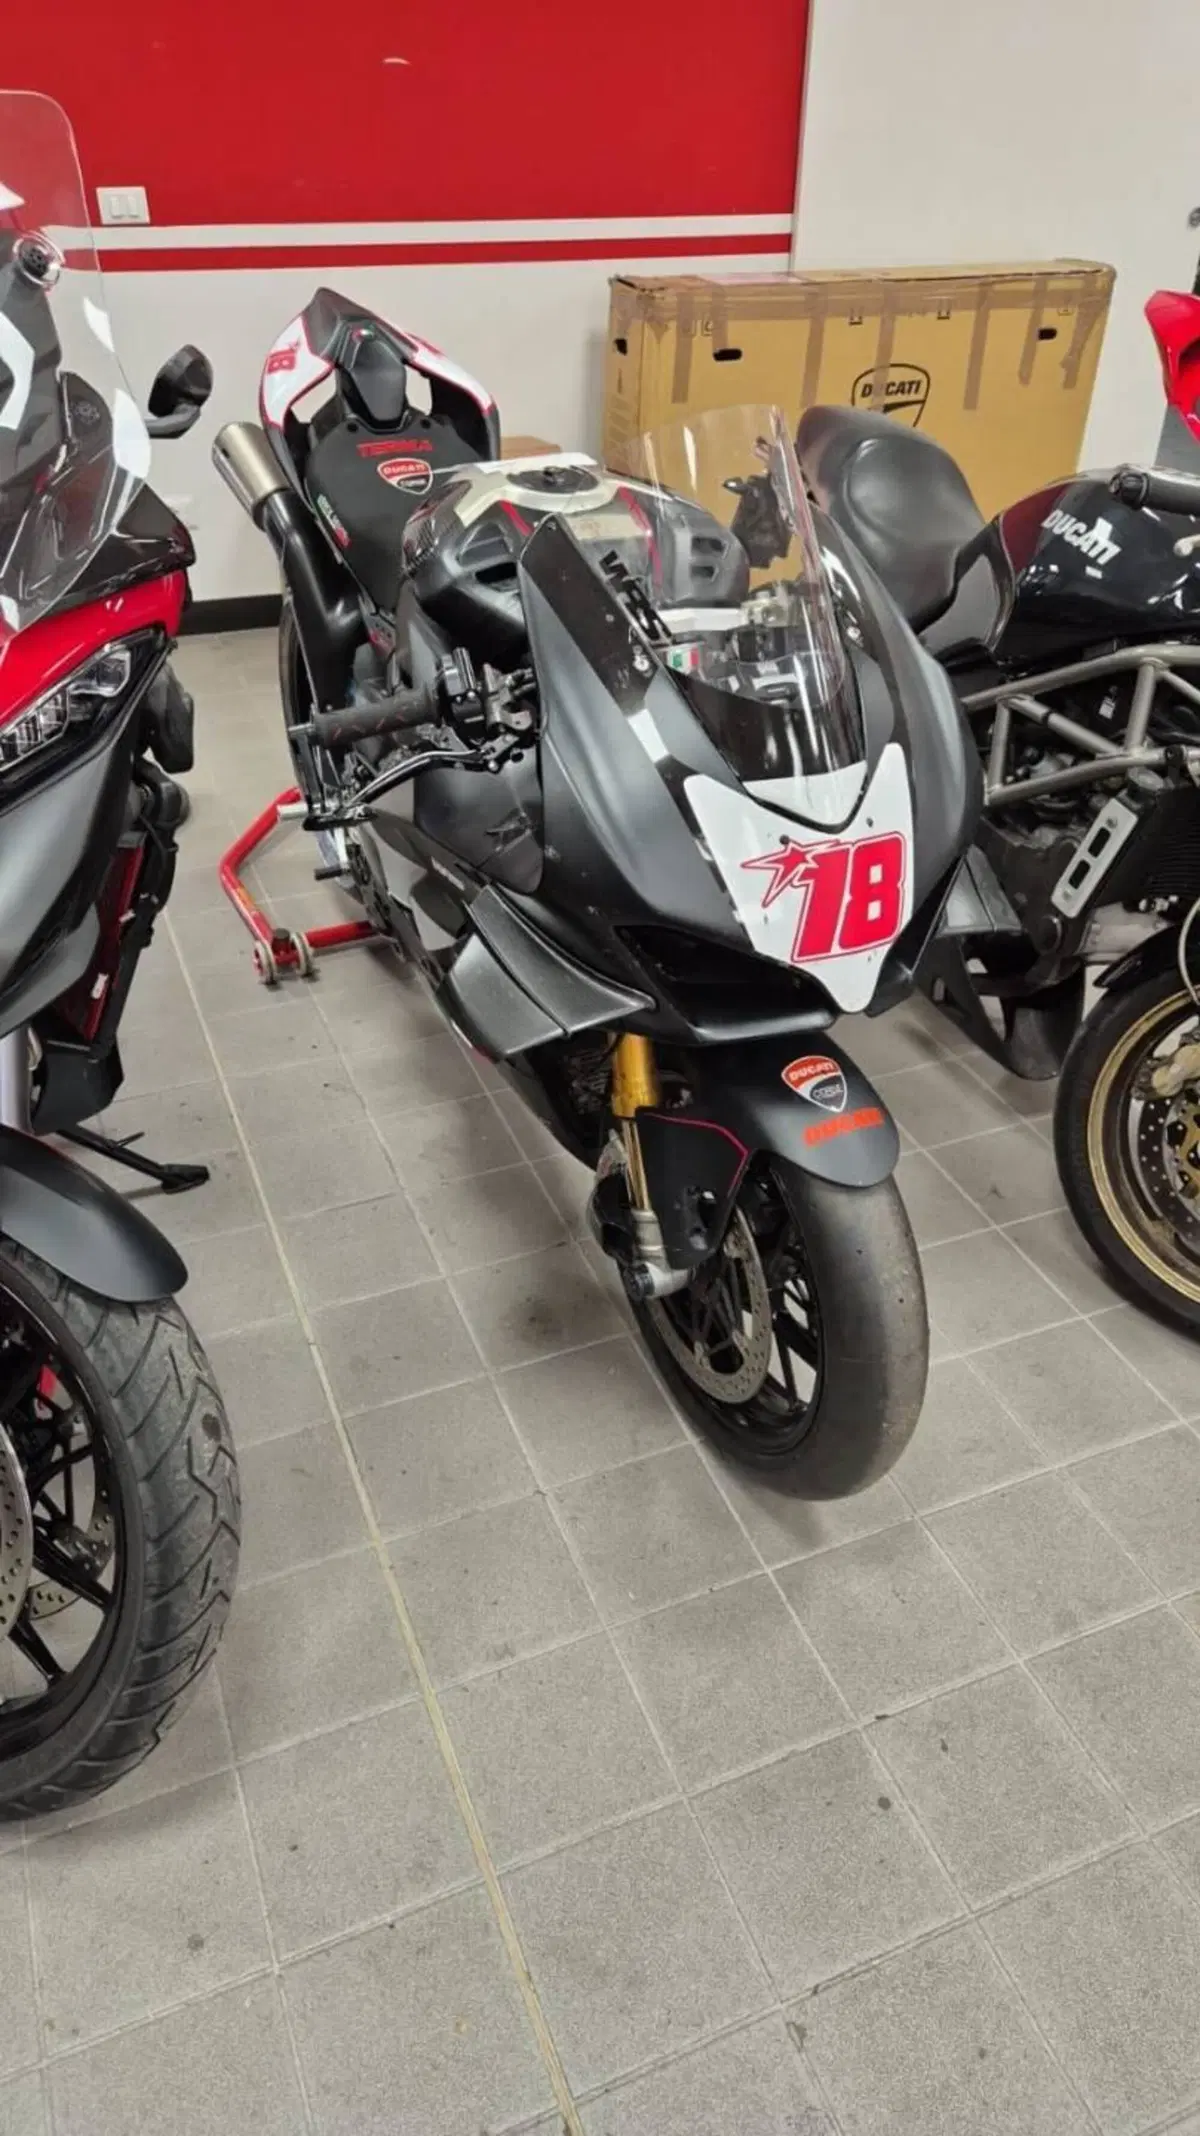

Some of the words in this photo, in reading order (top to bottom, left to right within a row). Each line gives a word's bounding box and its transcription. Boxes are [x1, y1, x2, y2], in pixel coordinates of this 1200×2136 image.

[861, 380, 922, 398] DCATI
[1041, 510, 1121, 565] DUCATI
[791, 832, 907, 963] 18
[788, 1062, 834, 1082] DUCATI
